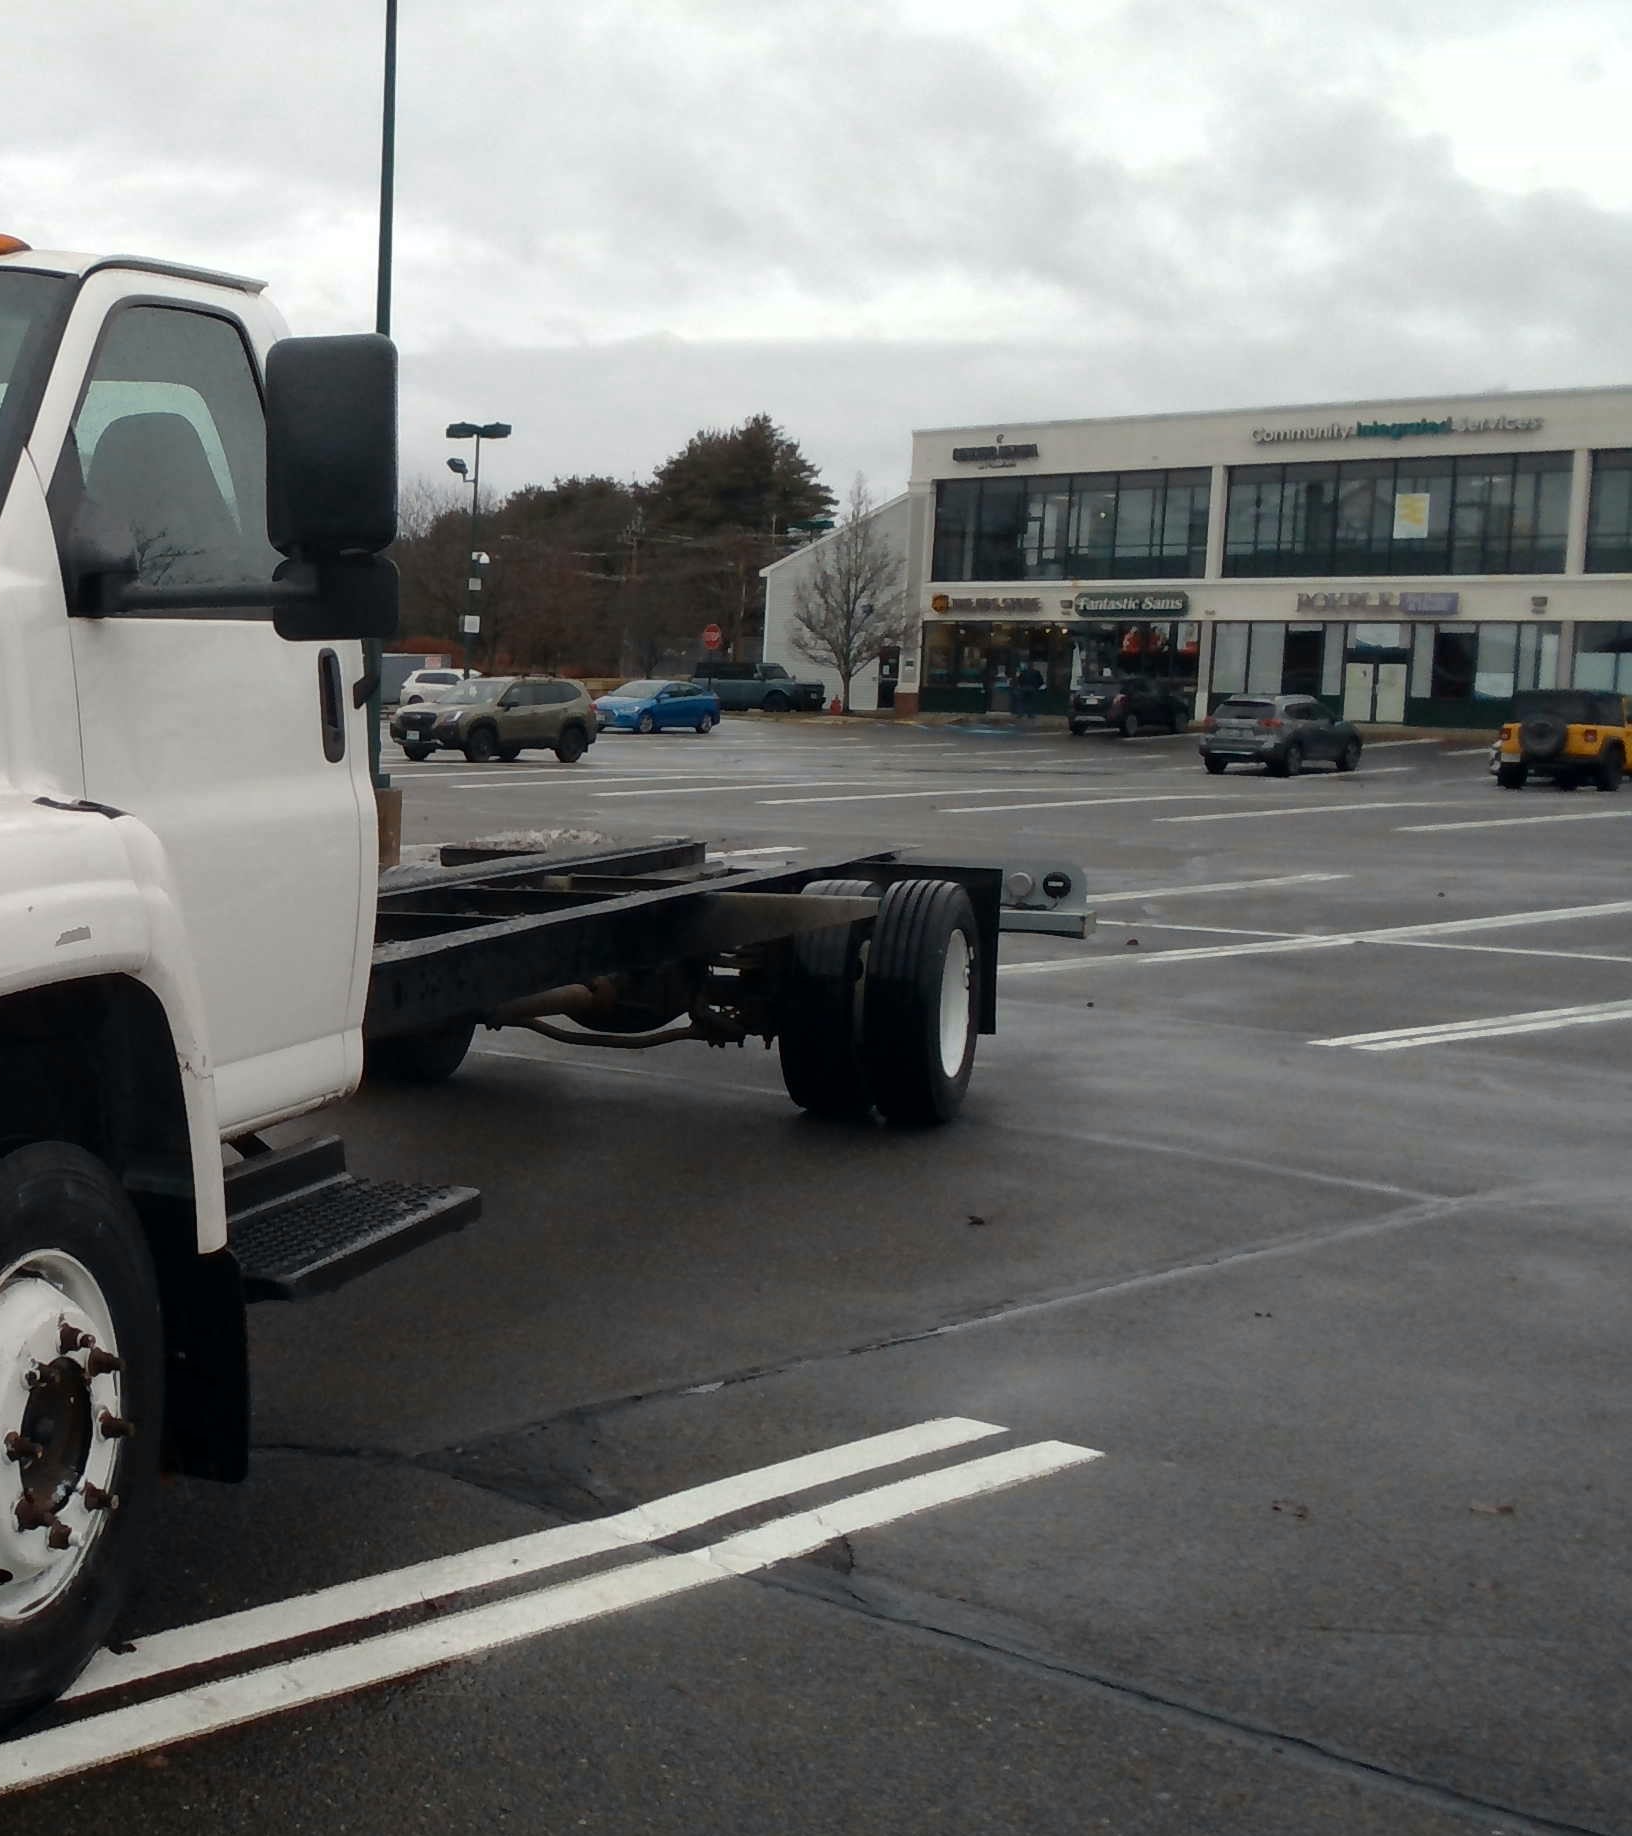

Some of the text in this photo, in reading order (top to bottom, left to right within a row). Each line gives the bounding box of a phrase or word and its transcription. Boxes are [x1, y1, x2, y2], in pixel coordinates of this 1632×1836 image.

[1251, 423, 1350, 445] Community
[1077, 596, 1138, 610] Fantastic
[1141, 595, 1183, 610] Sams
